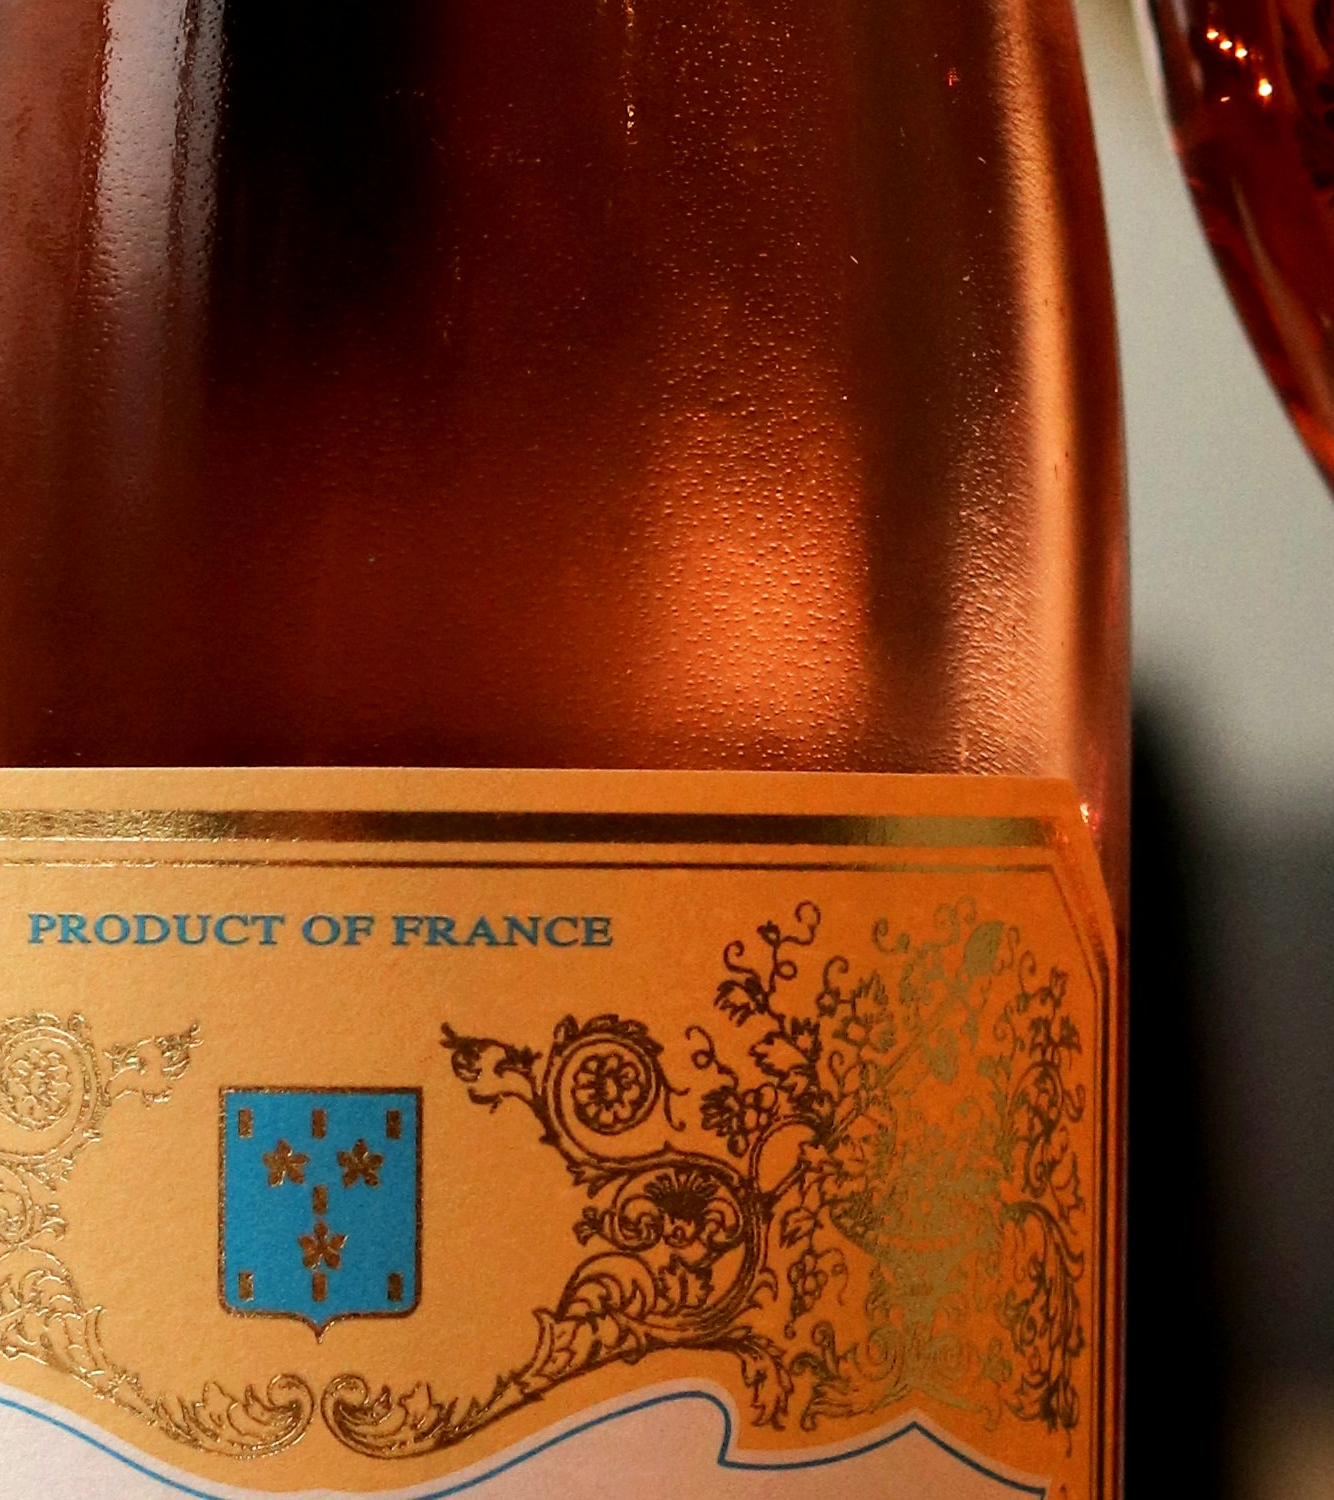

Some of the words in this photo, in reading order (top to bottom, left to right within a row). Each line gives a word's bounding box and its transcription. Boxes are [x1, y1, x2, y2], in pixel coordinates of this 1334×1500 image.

[27, 912, 285, 946] PRODUCT
[301, 913, 376, 947] OF
[391, 914, 614, 949] FRANCE
